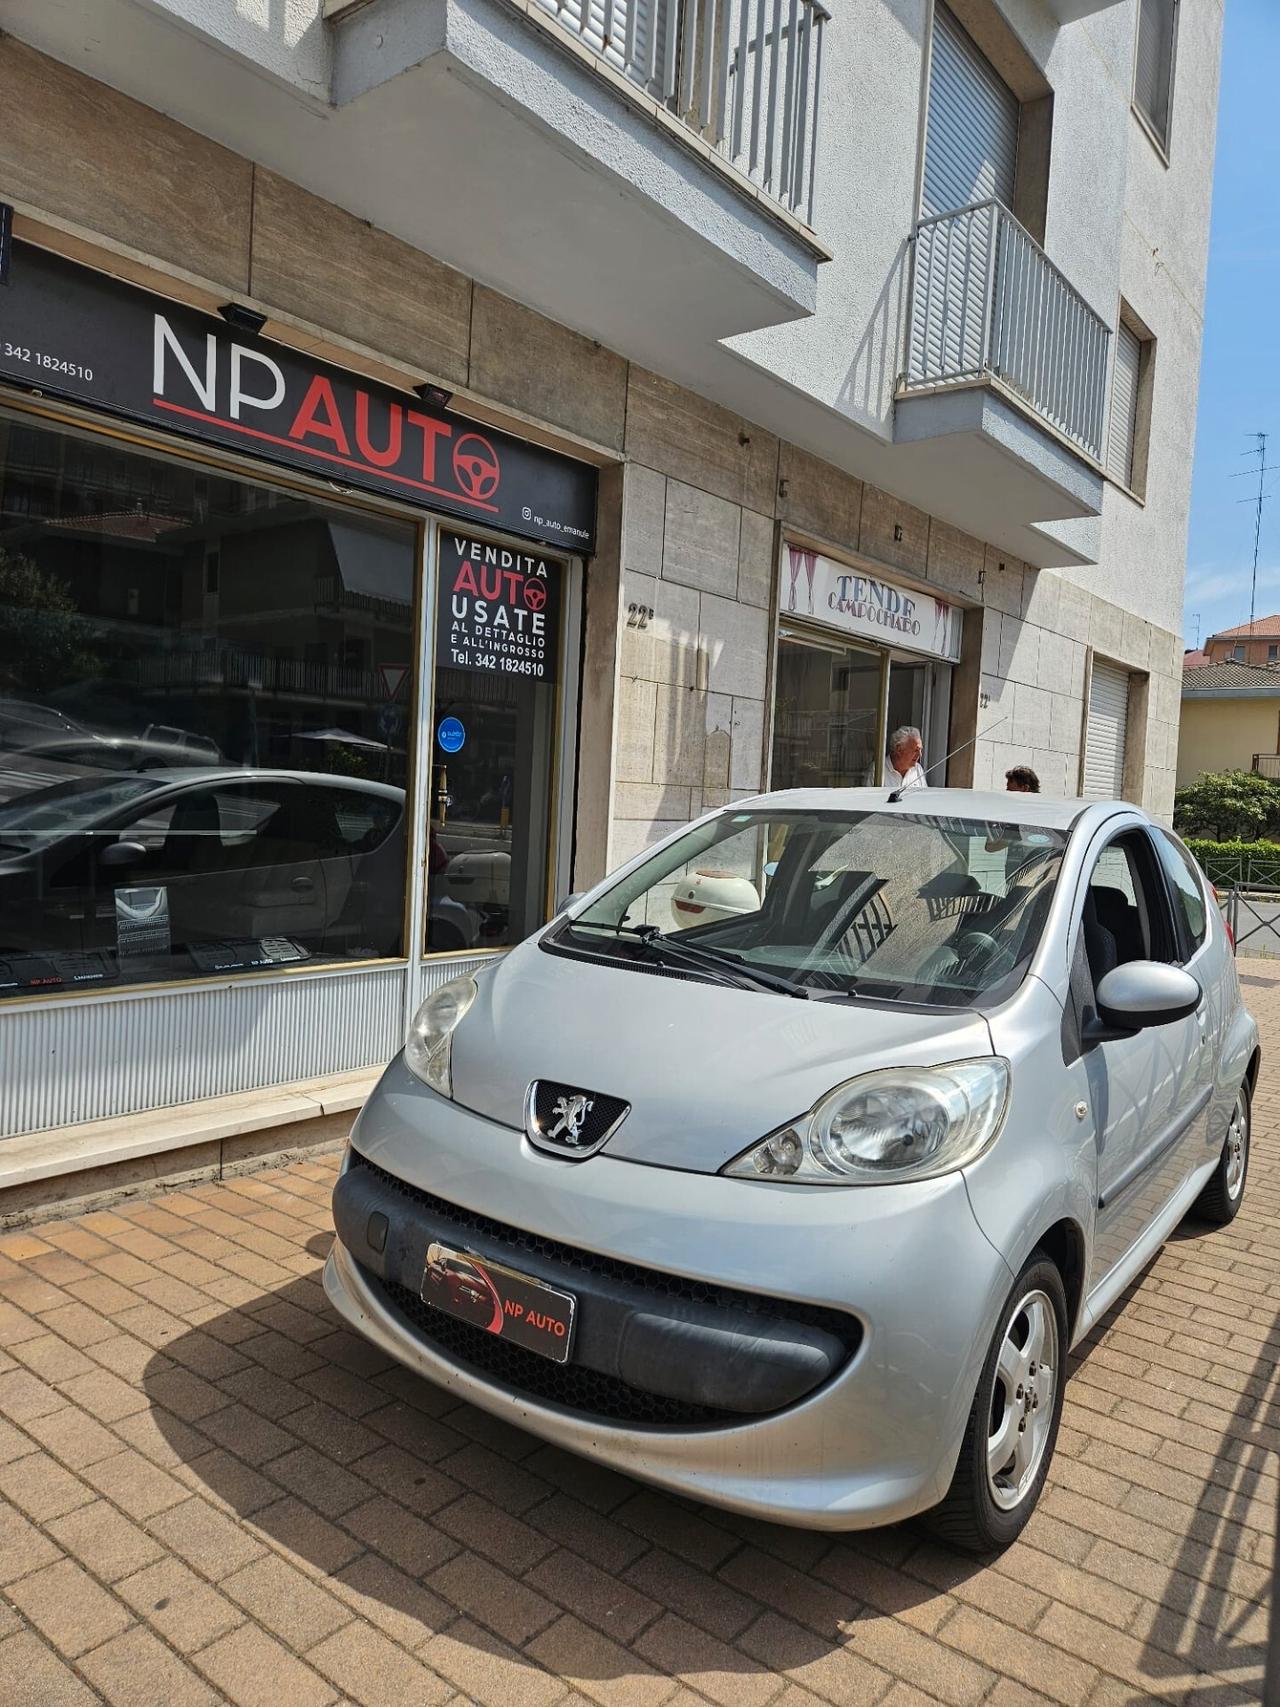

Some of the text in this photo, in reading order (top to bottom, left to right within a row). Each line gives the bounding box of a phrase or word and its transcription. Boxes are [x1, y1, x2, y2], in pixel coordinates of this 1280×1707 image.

[4, 343, 93, 381] 342 1824510
[454, 537, 548, 578] VENDITA
[451, 595, 546, 635] USATE
[451, 620, 546, 648] AL DETTAGLIO
[451, 634, 545, 660] E ALL'INGROSSO
[451, 648, 545, 677] Tel. 342 1824510
[504, 1300, 566, 1338] NP AUTO
